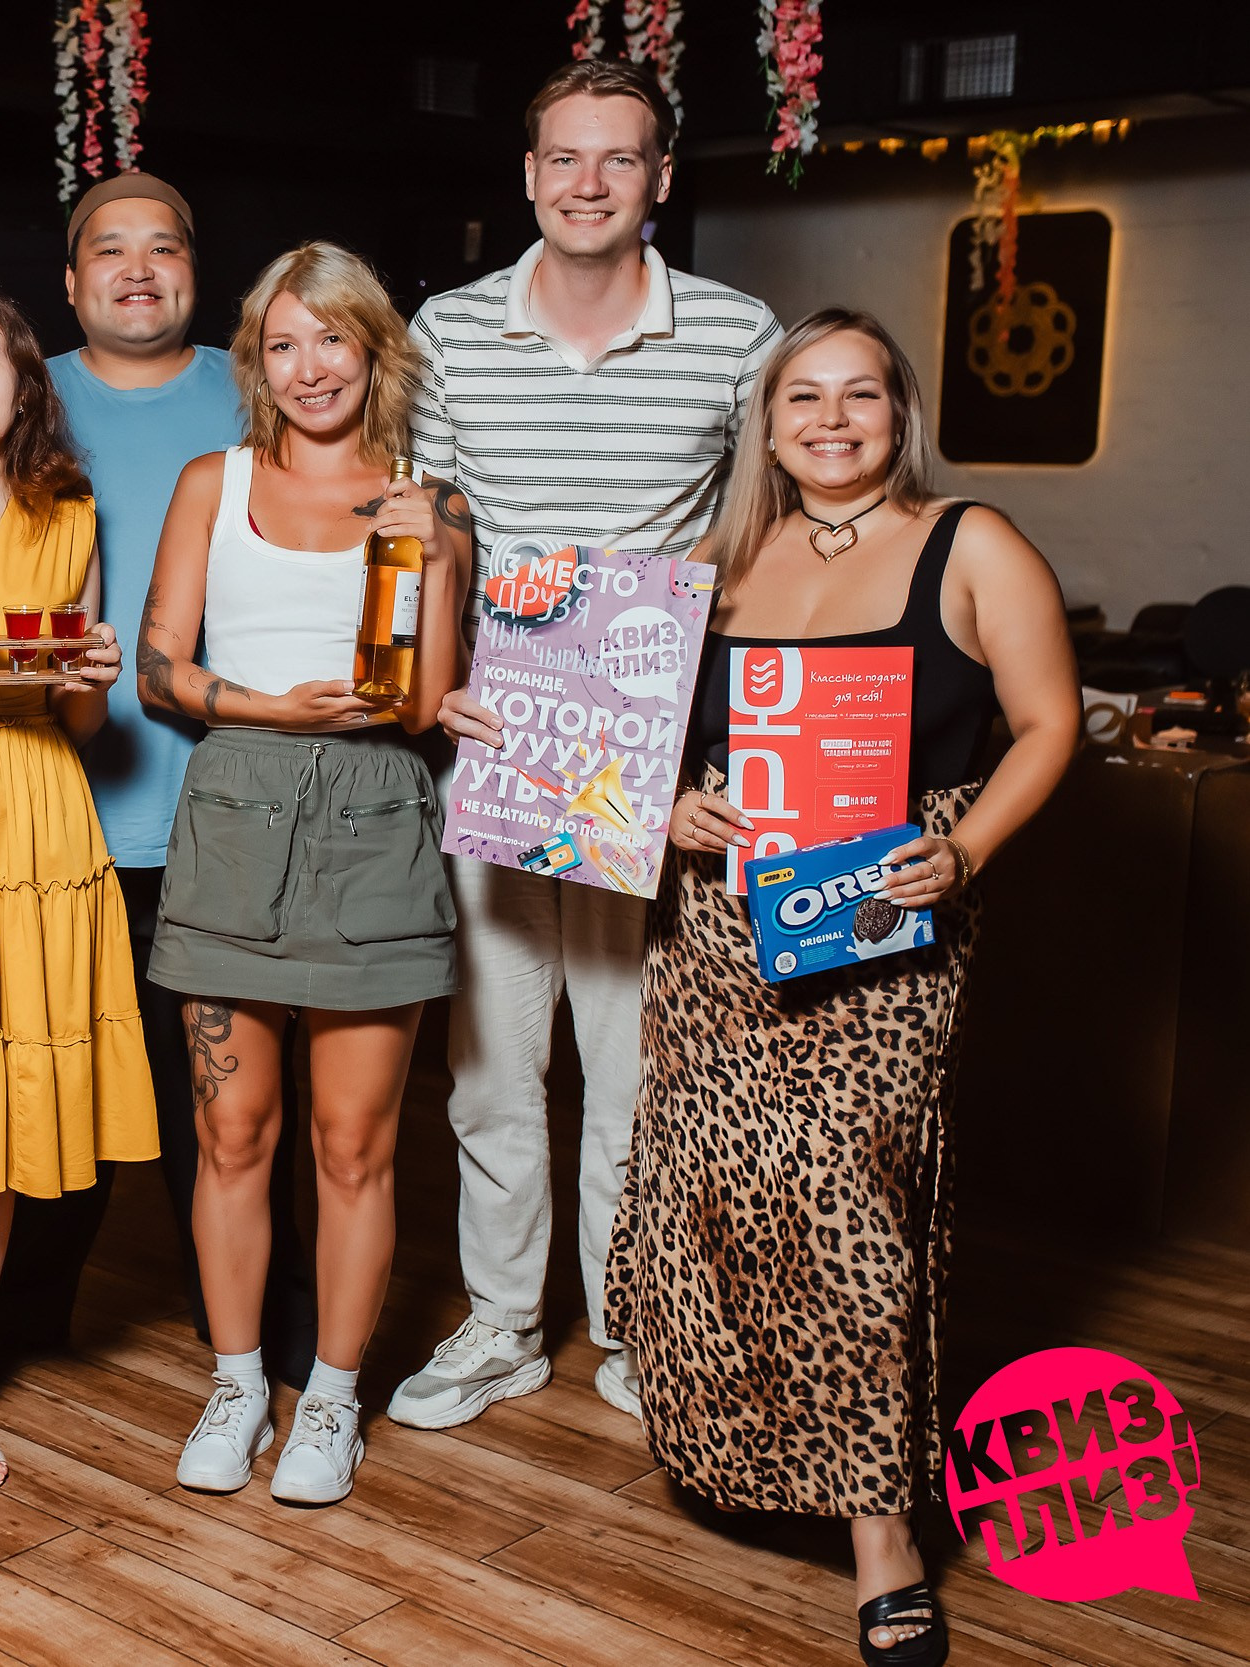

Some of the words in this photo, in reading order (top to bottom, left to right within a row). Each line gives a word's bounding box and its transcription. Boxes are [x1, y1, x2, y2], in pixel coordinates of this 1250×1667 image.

[501, 553, 521, 578] 3
[527, 556, 639, 597] МЕСТО
[484, 665, 567, 694] КОМАНДЕ,
[810, 671, 862, 683] Классные
[865, 673, 906, 688] подарки
[832, 692, 852, 708] для
[856, 689, 883, 702] тебя!
[479, 687, 678, 755] КОТОРОЙ
[824, 748, 851, 757] (СЛАДКИЙ
[863, 748, 892, 756] КЛАССИКА)
[850, 797, 859, 805] НА
[860, 796, 878, 805] КОФЕ
[461, 798, 480, 813] НЕ
[482, 803, 551, 828] ХВАТИЛО
[553, 819, 577, 833] ДО
[800, 930, 844, 948] ORIGINAL
